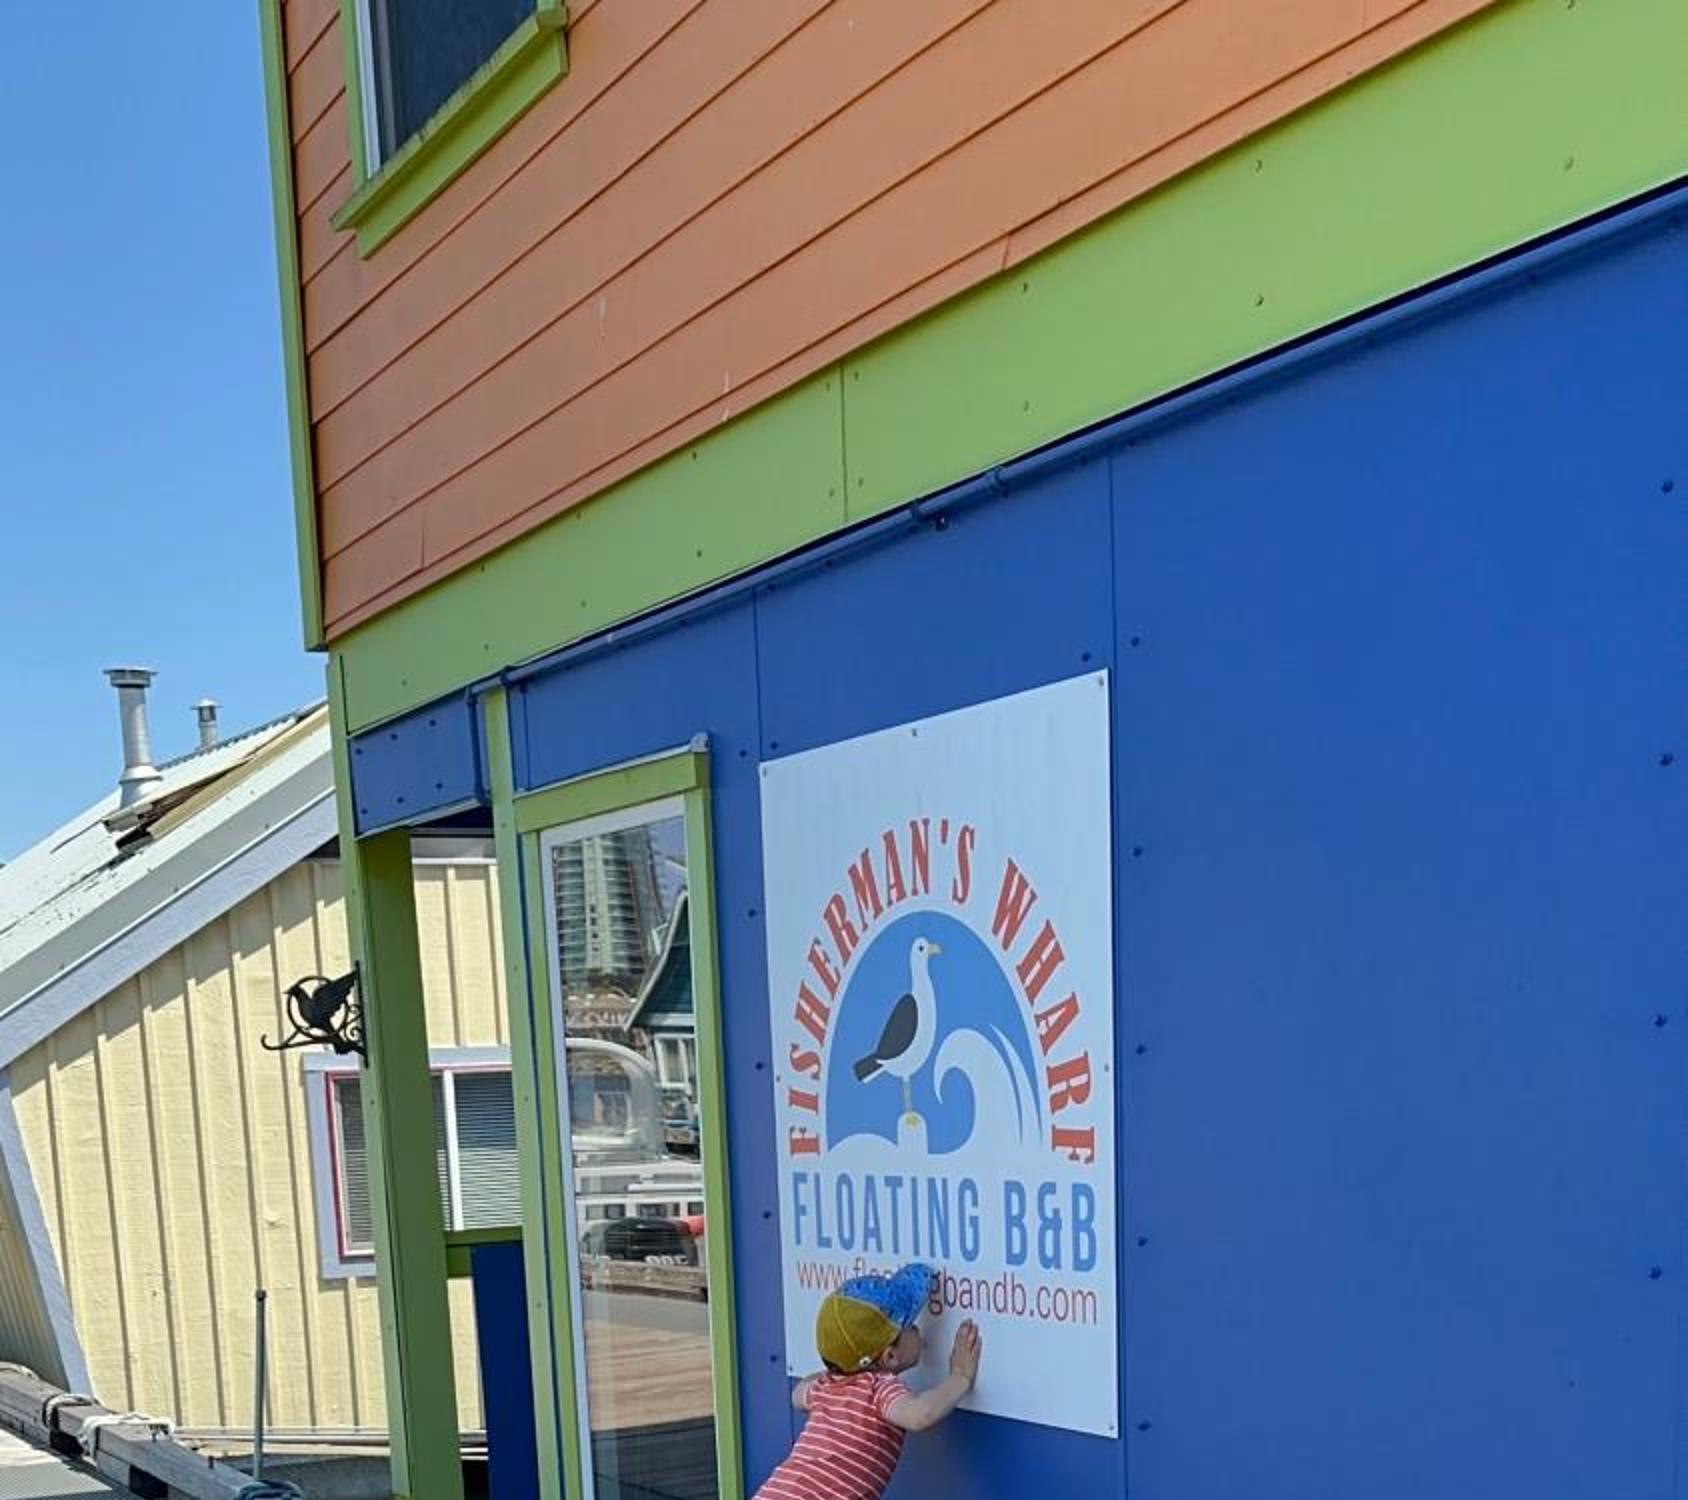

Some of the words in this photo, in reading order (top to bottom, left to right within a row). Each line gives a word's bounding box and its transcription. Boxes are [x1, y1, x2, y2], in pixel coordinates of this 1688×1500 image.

[788, 817, 976, 1157] FISHERMAN'S
[992, 857, 1096, 1164] WHARF
[793, 1172, 980, 1262] FLOATING
[1003, 1180, 1098, 1273] B&B
